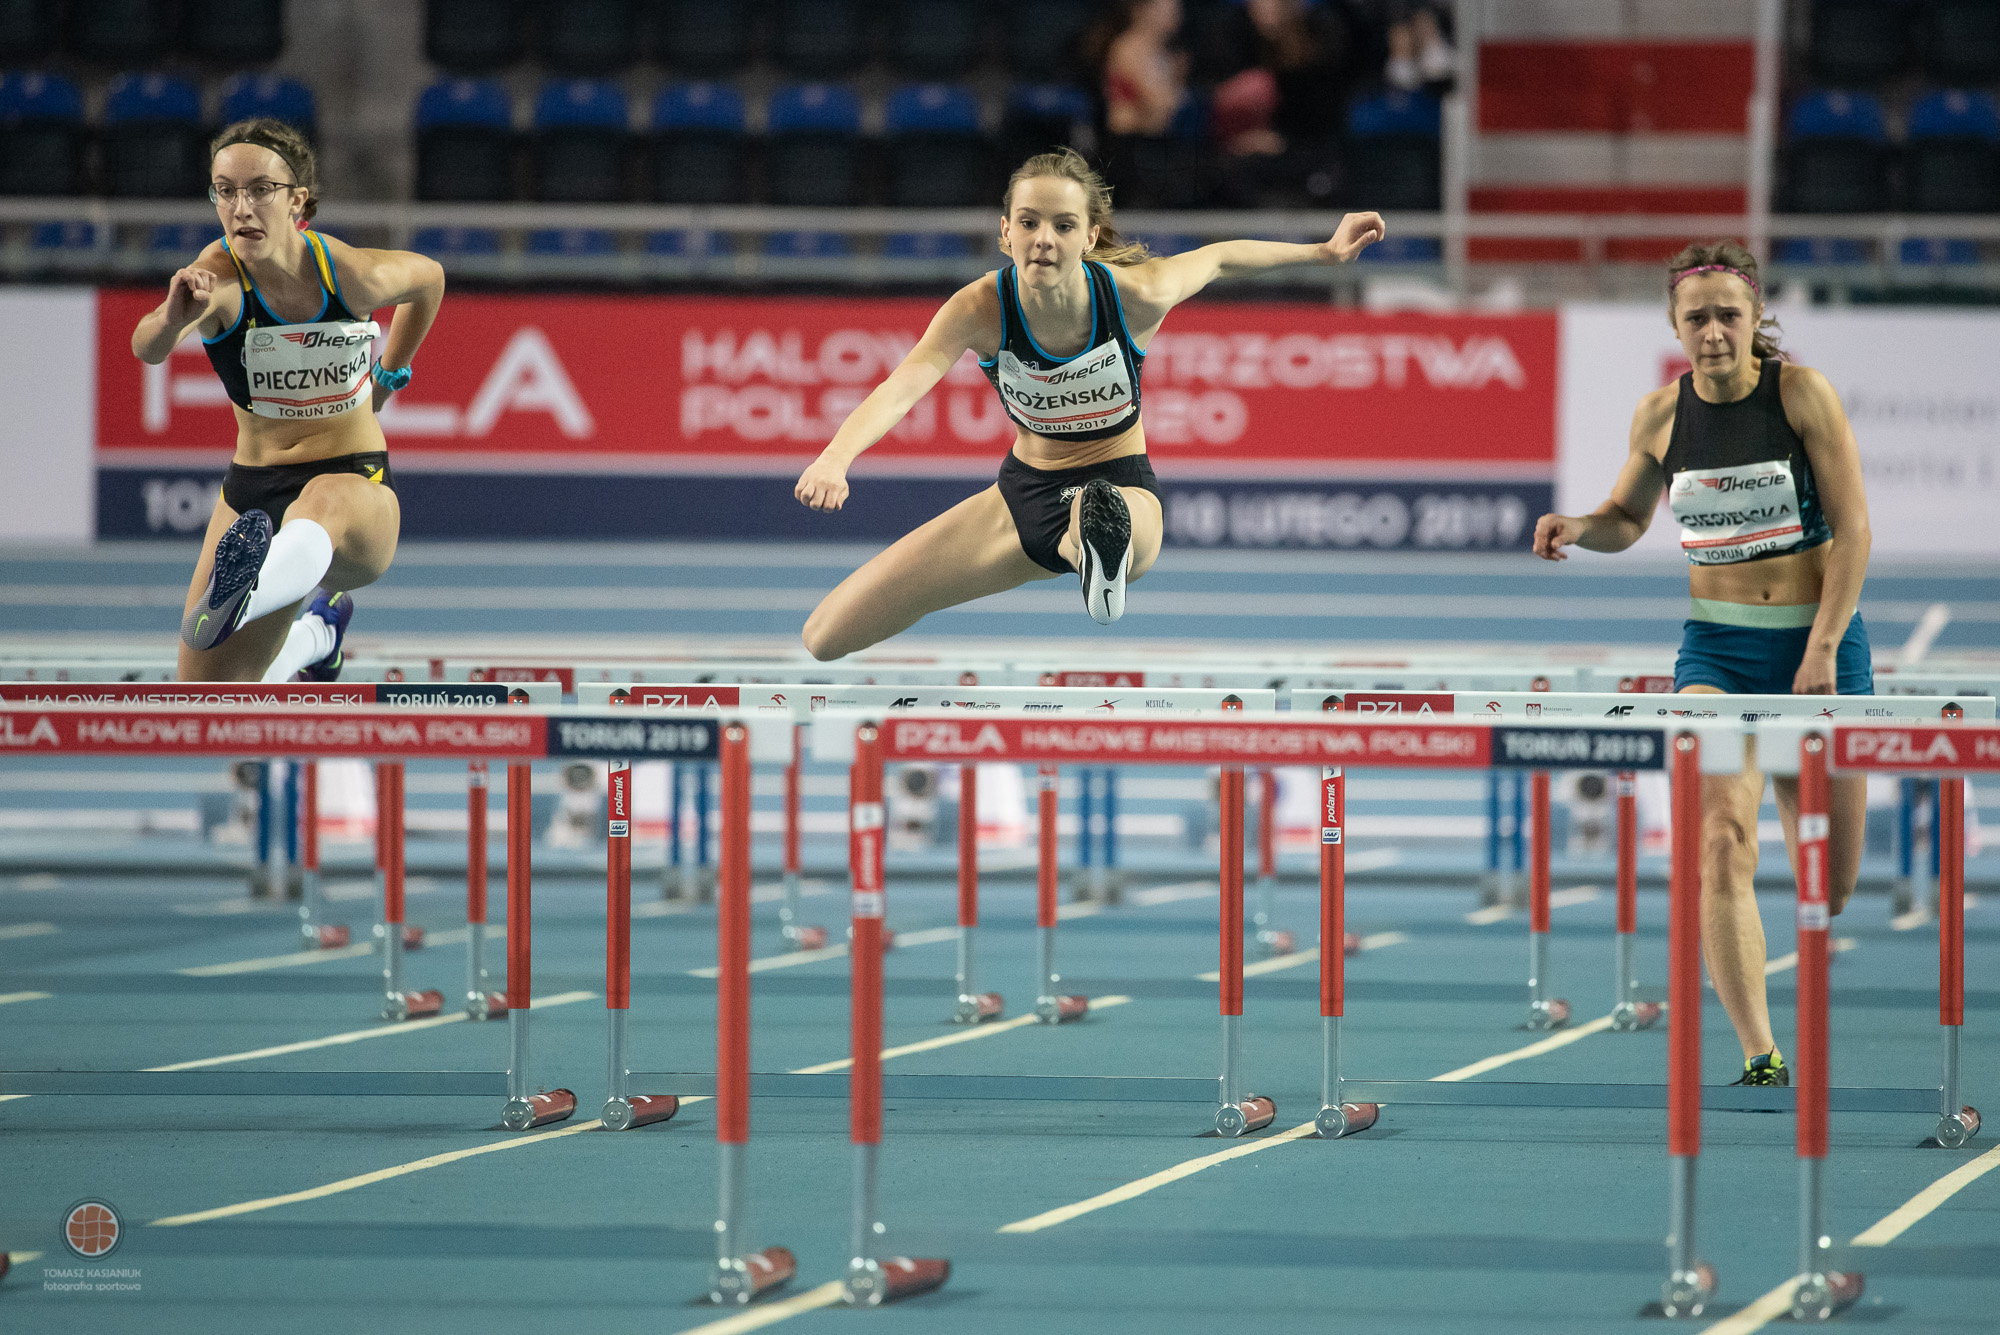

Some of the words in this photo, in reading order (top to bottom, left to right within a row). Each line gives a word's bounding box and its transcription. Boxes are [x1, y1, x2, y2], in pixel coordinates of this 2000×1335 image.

[253, 351, 367, 390] PIECZYŃSKA
[1003, 382, 1126, 411] ROŻEŃSKA
[279, 404, 323, 418] TORUŃ
[328, 398, 357, 414] 2019
[1027, 420, 1072, 432] TORUŃ
[1076, 418, 1108, 430] 2019
[1705, 546, 1744, 561] TORUŃ
[1746, 540, 1777, 557] 2019
[25, 694, 115, 707] HALOWE
[122, 694, 280, 707] MISTRZOSTWA
[287, 694, 363, 708] POLSKI
[386, 691, 449, 708] TORUŃ
[453, 694, 497, 708] 2019
[643, 694, 722, 712] PZLA
[1145, 699, 1165, 708] NESTLÉ
[1357, 701, 1437, 719] PZLA
[1865, 708, 1885, 717] NESTLÉ
[77, 719, 199, 745] HALOWE
[207, 719, 421, 746] MISTRZOSTWA
[426, 720, 532, 747] POLSKI
[558, 721, 645, 750] TORUŃ
[650, 724, 710, 751] 2019
[895, 721, 1007, 754] PZLA
[1022, 725, 1145, 752] HALOWE
[1154, 727, 1366, 755] MISTRZOSTWA
[1370, 730, 1477, 758] POLSKI
[1503, 729, 1591, 759] TORUŃ
[1593, 732, 1655, 762] 2019
[1846, 729, 1959, 763] PZLA
[614, 776, 625, 816] polanik
[1326, 783, 1337, 823] polanik
